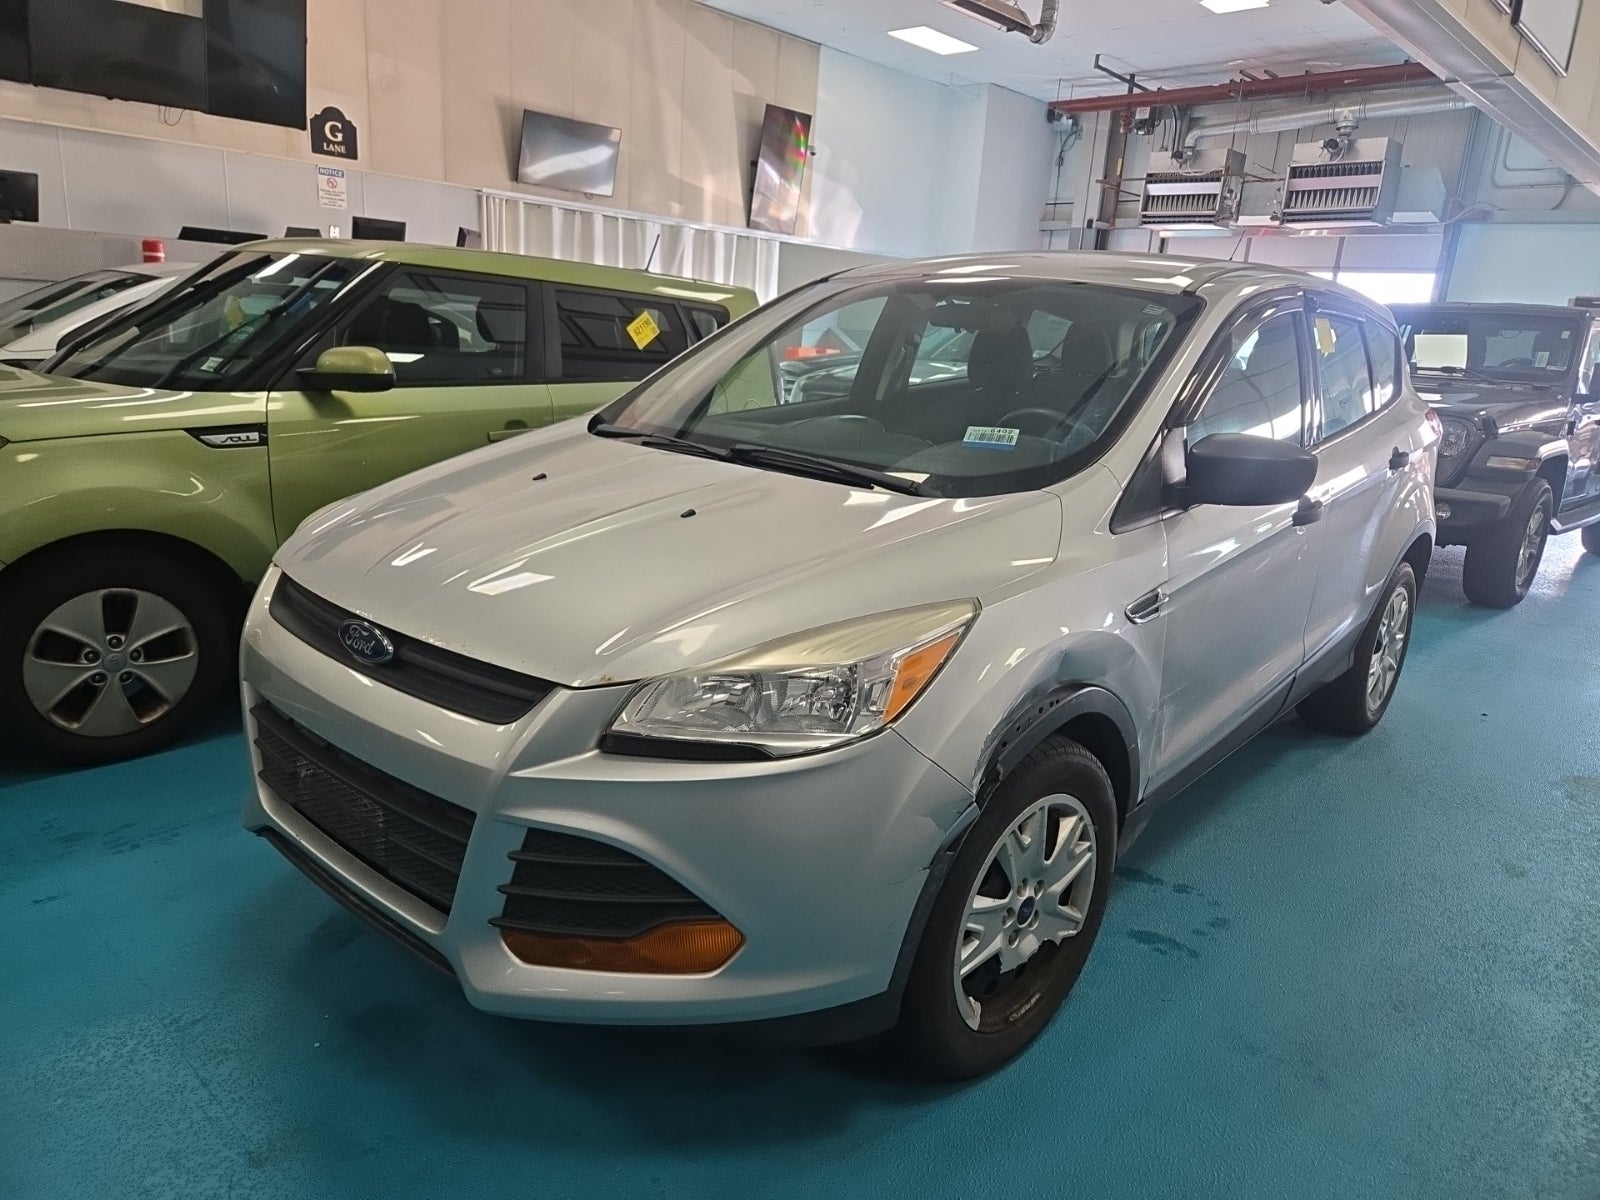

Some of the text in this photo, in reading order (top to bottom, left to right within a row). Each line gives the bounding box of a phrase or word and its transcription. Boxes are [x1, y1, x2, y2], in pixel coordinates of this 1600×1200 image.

[324, 121, 343, 142] G
[323, 142, 347, 154] LANE
[319, 168, 343, 177] NOTICE
[345, 625, 375, 655] Ford
